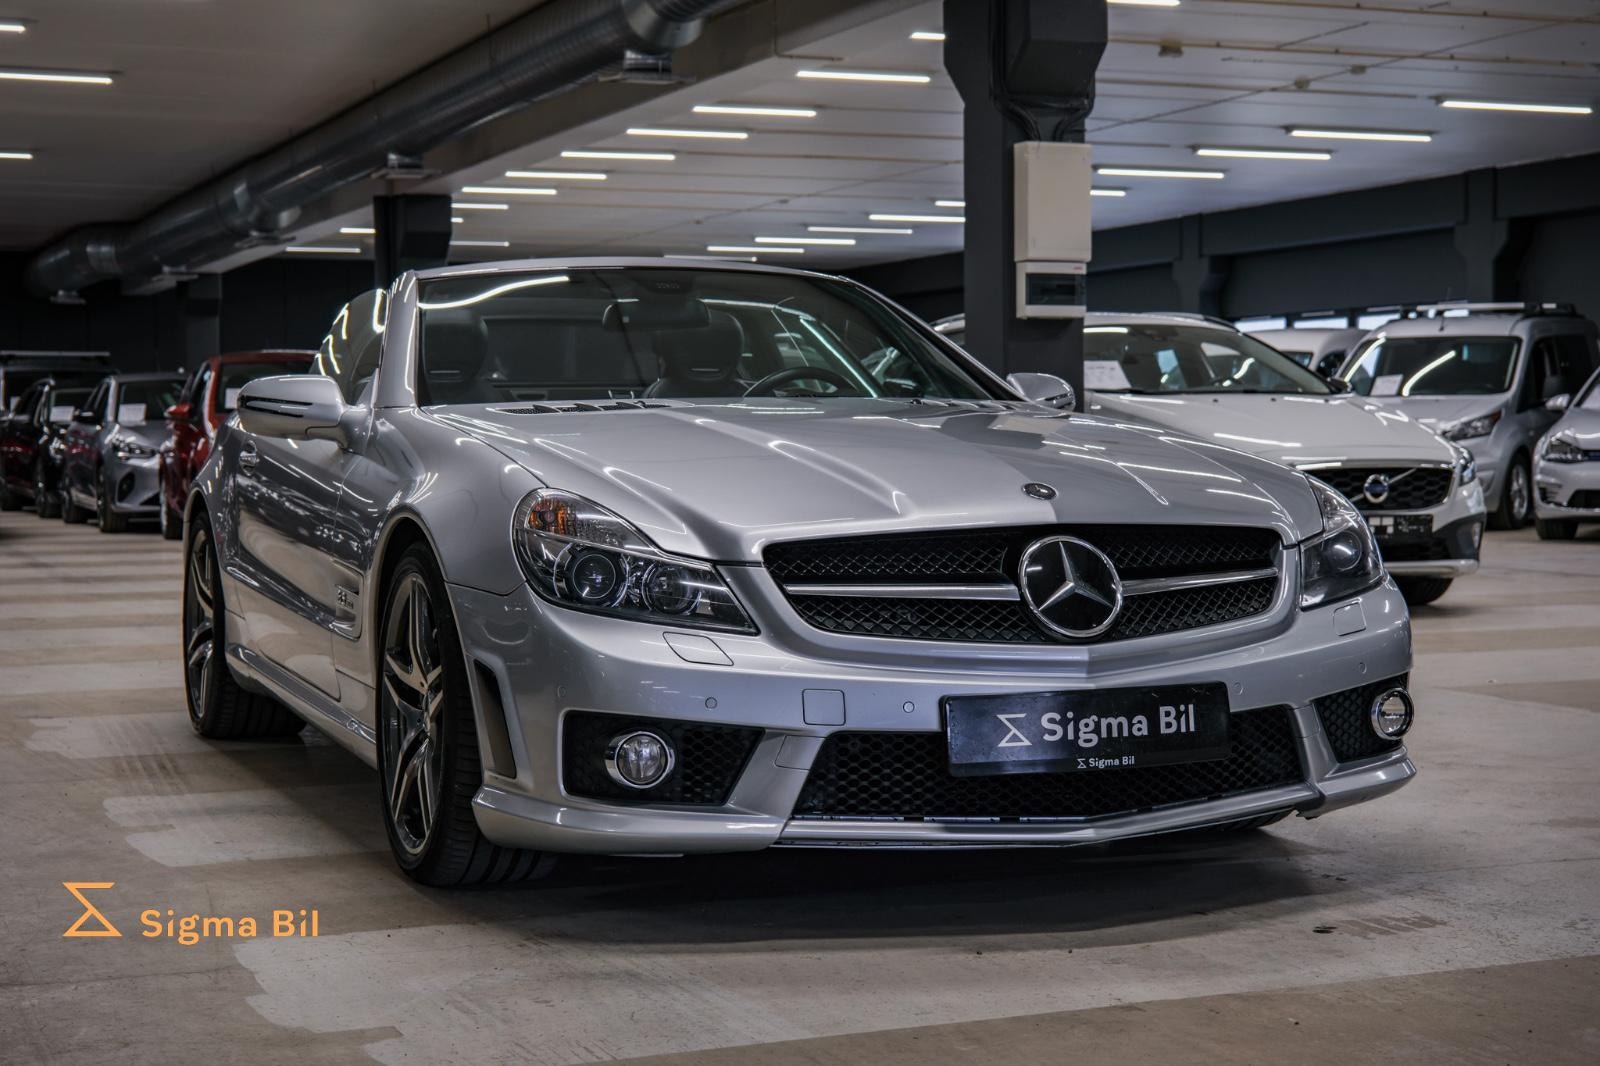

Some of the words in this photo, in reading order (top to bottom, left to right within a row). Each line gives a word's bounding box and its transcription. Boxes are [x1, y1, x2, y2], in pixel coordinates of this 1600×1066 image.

[1040, 711, 1149, 748] Sigma
[1159, 704, 1196, 735] Bil
[1089, 757, 1120, 768] Sigma
[1122, 756, 1135, 766] Bil
